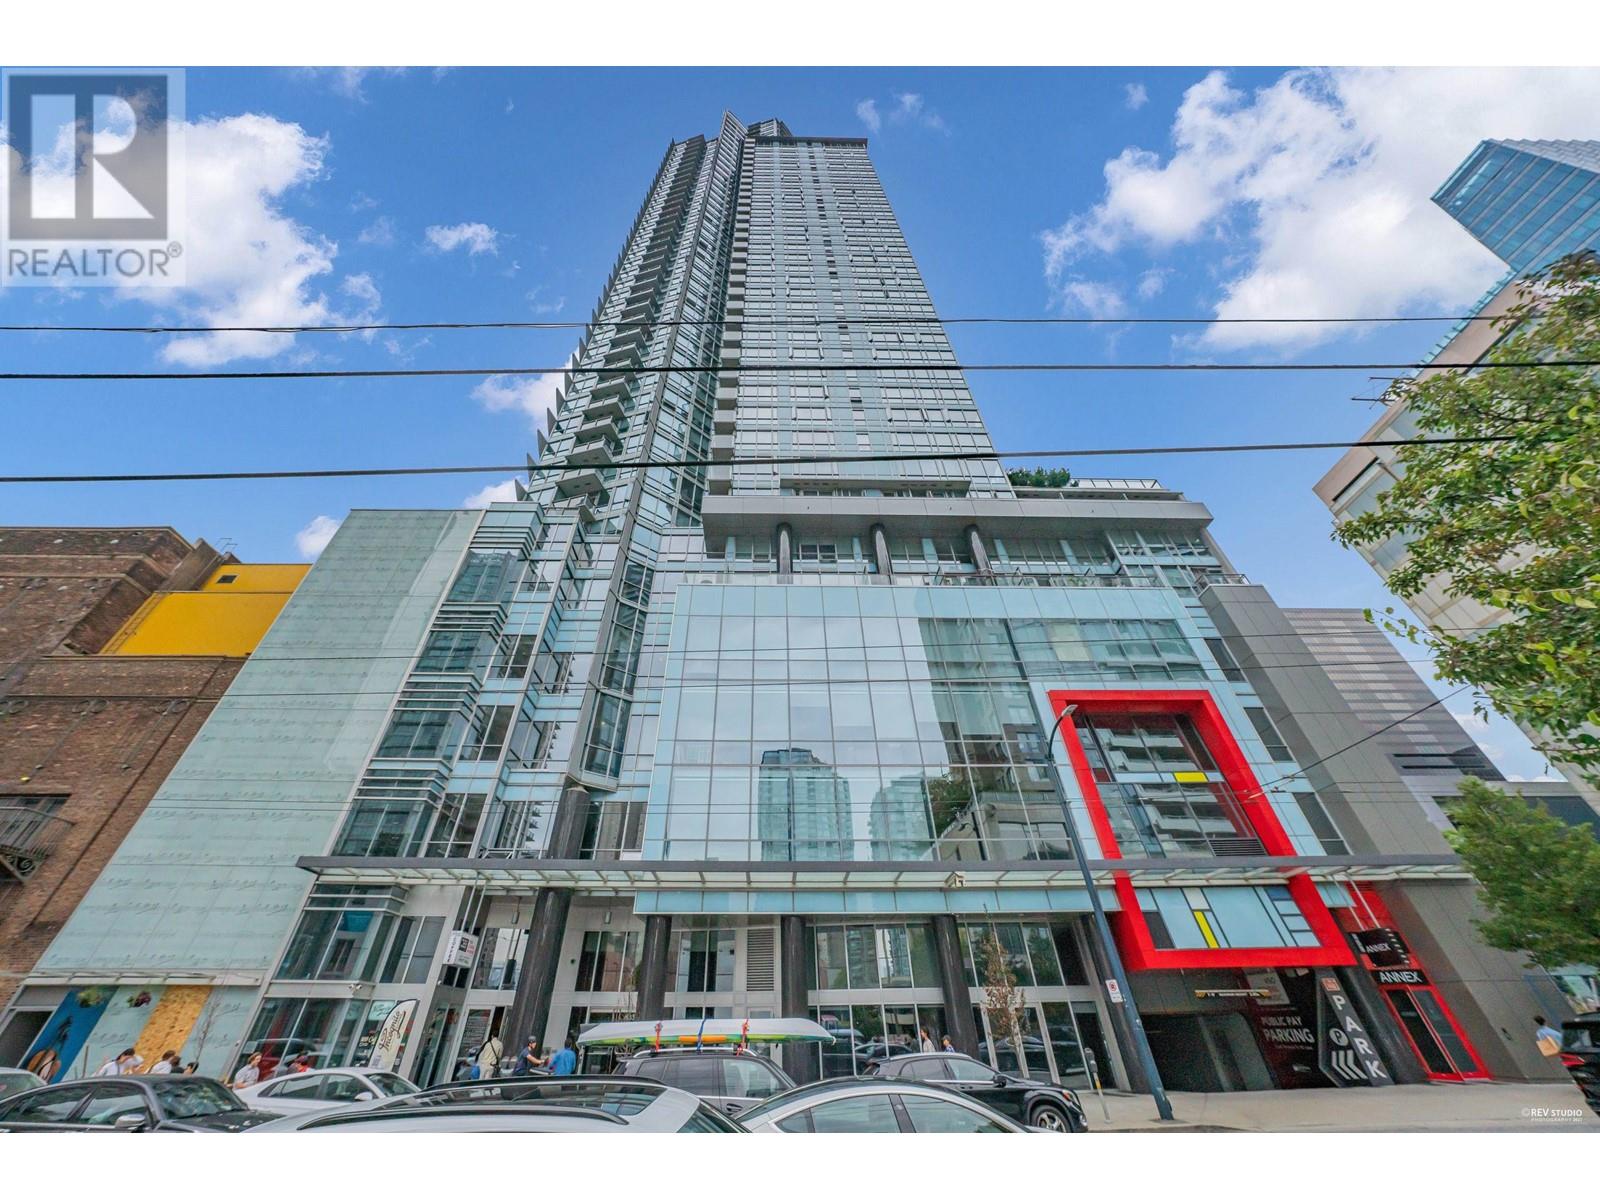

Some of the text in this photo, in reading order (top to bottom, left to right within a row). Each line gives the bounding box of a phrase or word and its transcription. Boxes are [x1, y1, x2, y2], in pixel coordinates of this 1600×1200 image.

[1366, 942, 1391, 953] ANNEX
[1380, 971, 1422, 983] ANNEX
[1261, 1016, 1303, 1026] PUBLIC PAY
[1263, 1028, 1315, 1043] PARKING
[1332, 995, 1387, 1078] PARK
